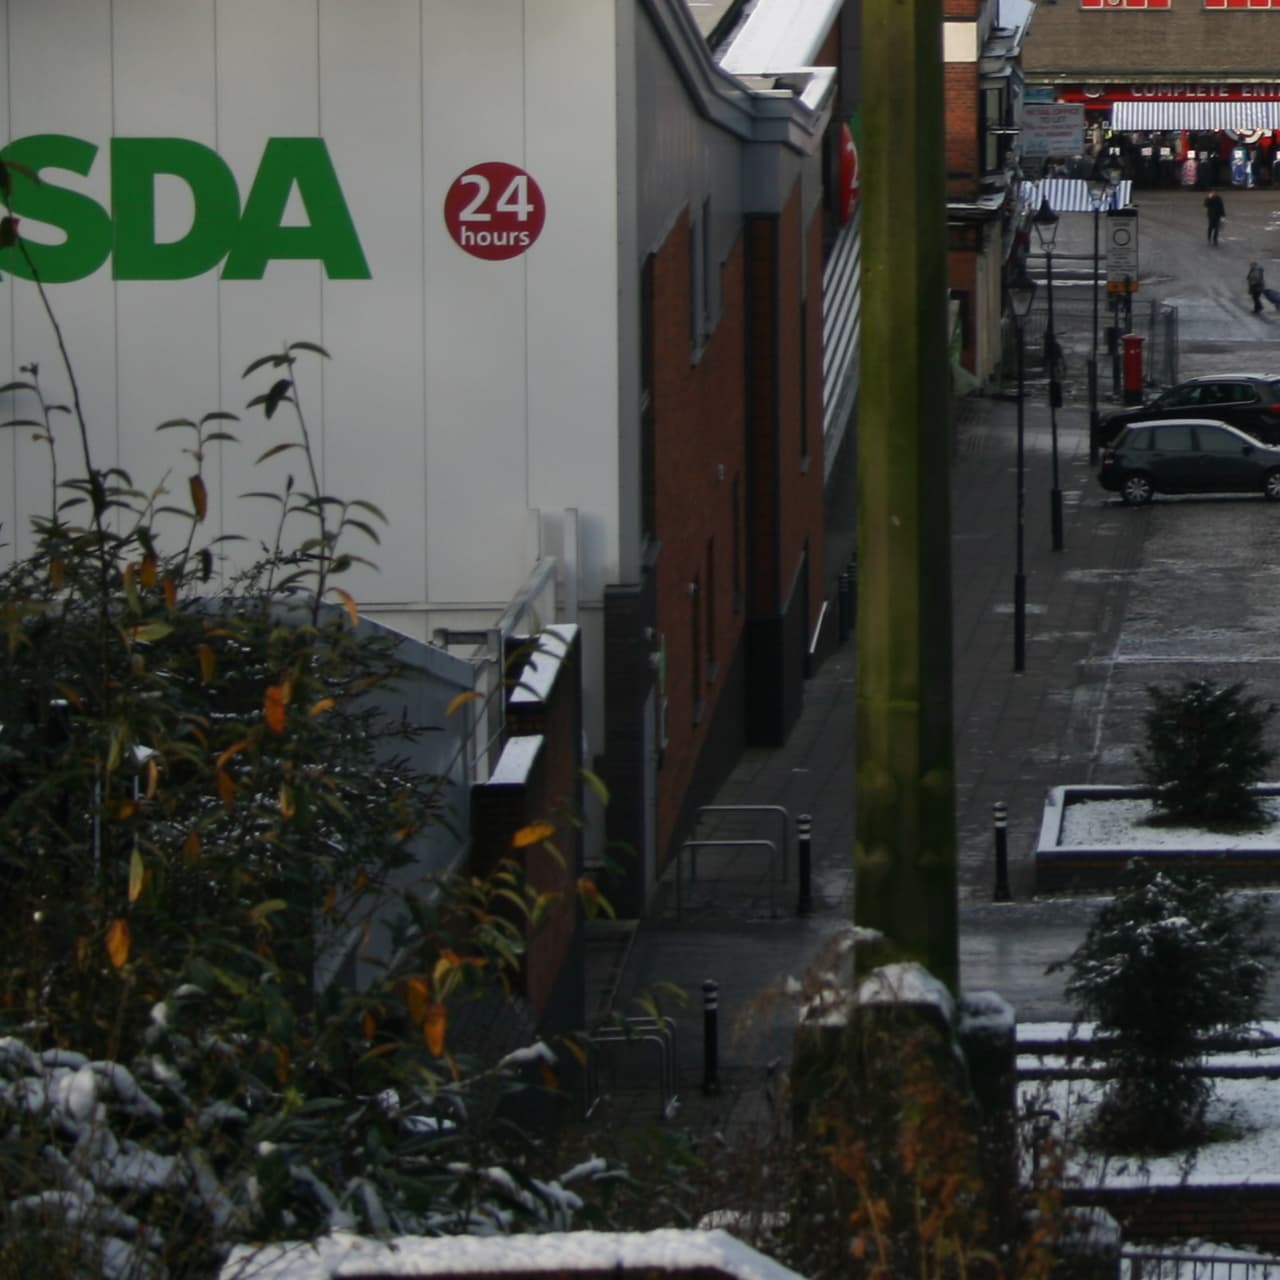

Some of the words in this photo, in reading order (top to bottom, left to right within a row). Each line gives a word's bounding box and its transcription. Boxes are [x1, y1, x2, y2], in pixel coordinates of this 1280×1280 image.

[1131, 84, 1229, 97] COMPLETE
[0, 134, 373, 283] SDA
[458, 174, 534, 221] 24
[460, 225, 531, 247] hours
